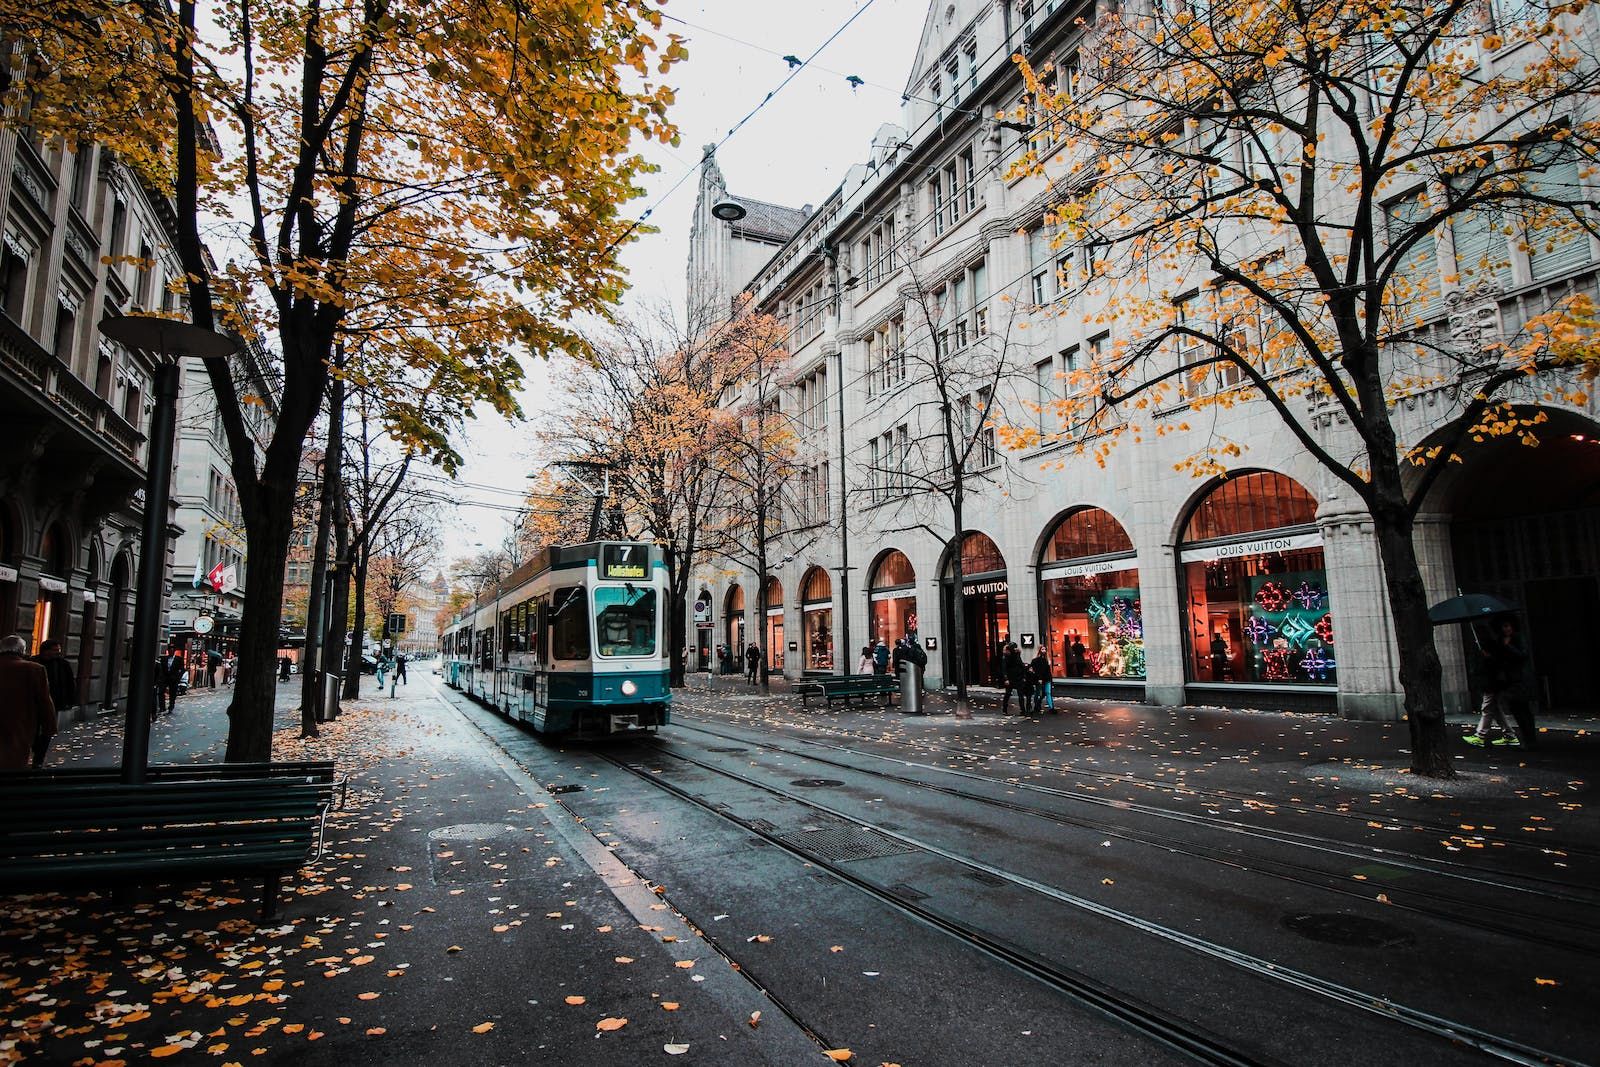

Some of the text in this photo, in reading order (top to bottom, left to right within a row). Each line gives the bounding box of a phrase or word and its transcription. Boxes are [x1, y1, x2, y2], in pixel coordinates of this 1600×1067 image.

[620, 545, 633, 561] 7
[1216, 539, 1291, 556] LOUIS VUITTON
[1085, 563, 1113, 572] VUITTON
[962, 585, 976, 596] UIS
